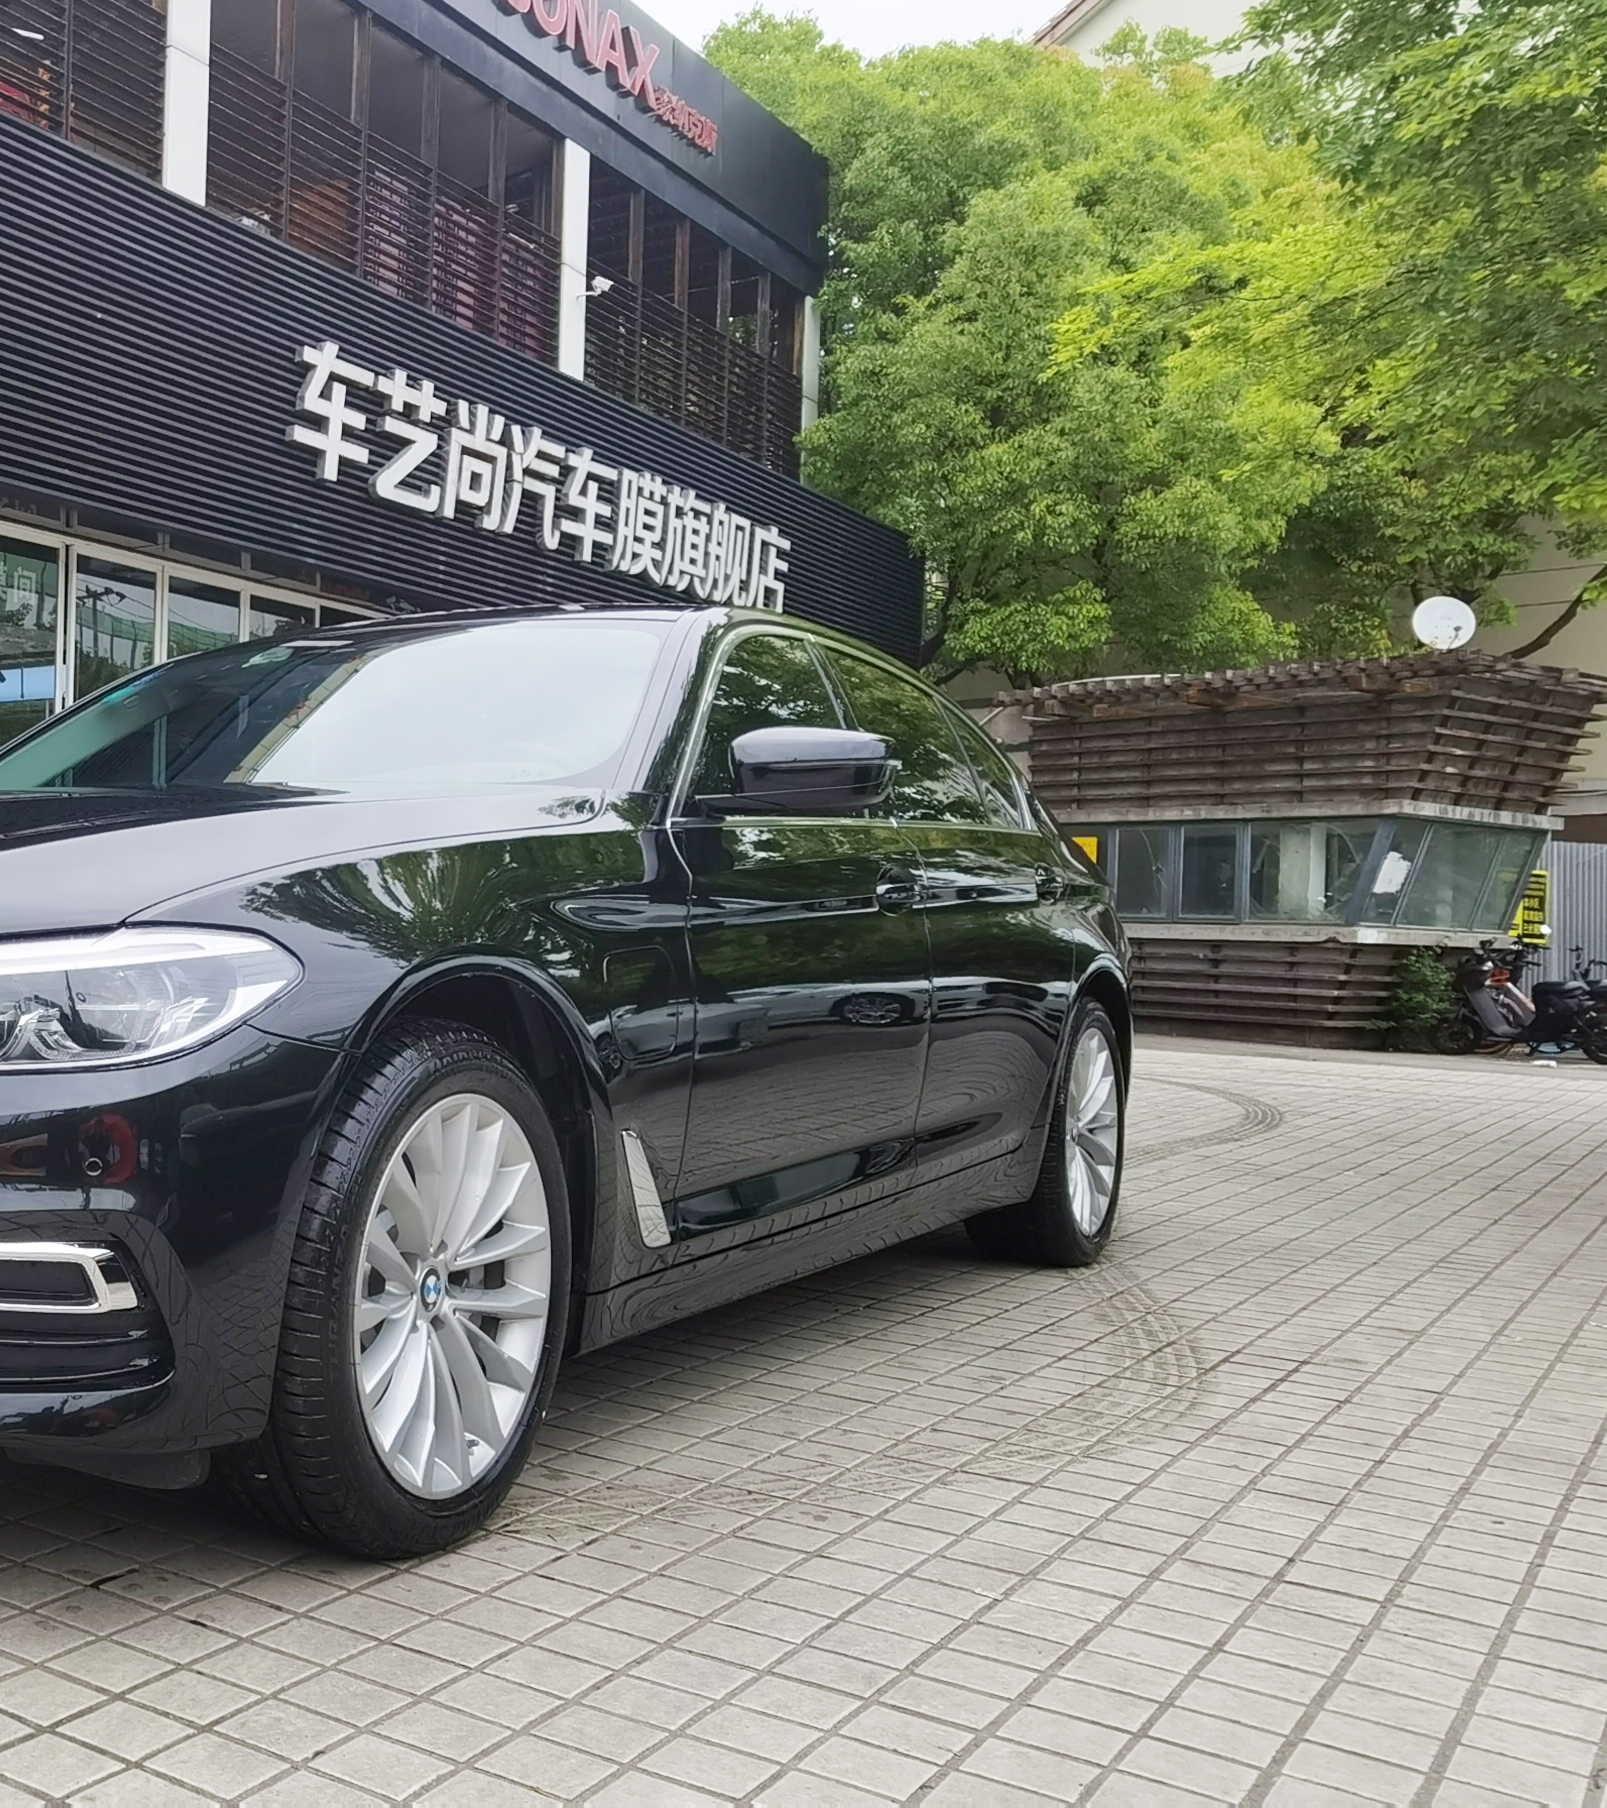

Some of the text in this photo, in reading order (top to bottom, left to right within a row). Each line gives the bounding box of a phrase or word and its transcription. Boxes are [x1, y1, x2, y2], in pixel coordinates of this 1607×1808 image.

[504, 0, 660, 111] ONAX
[285, 340, 792, 614] 车艺尚汽车膜旗舰店
